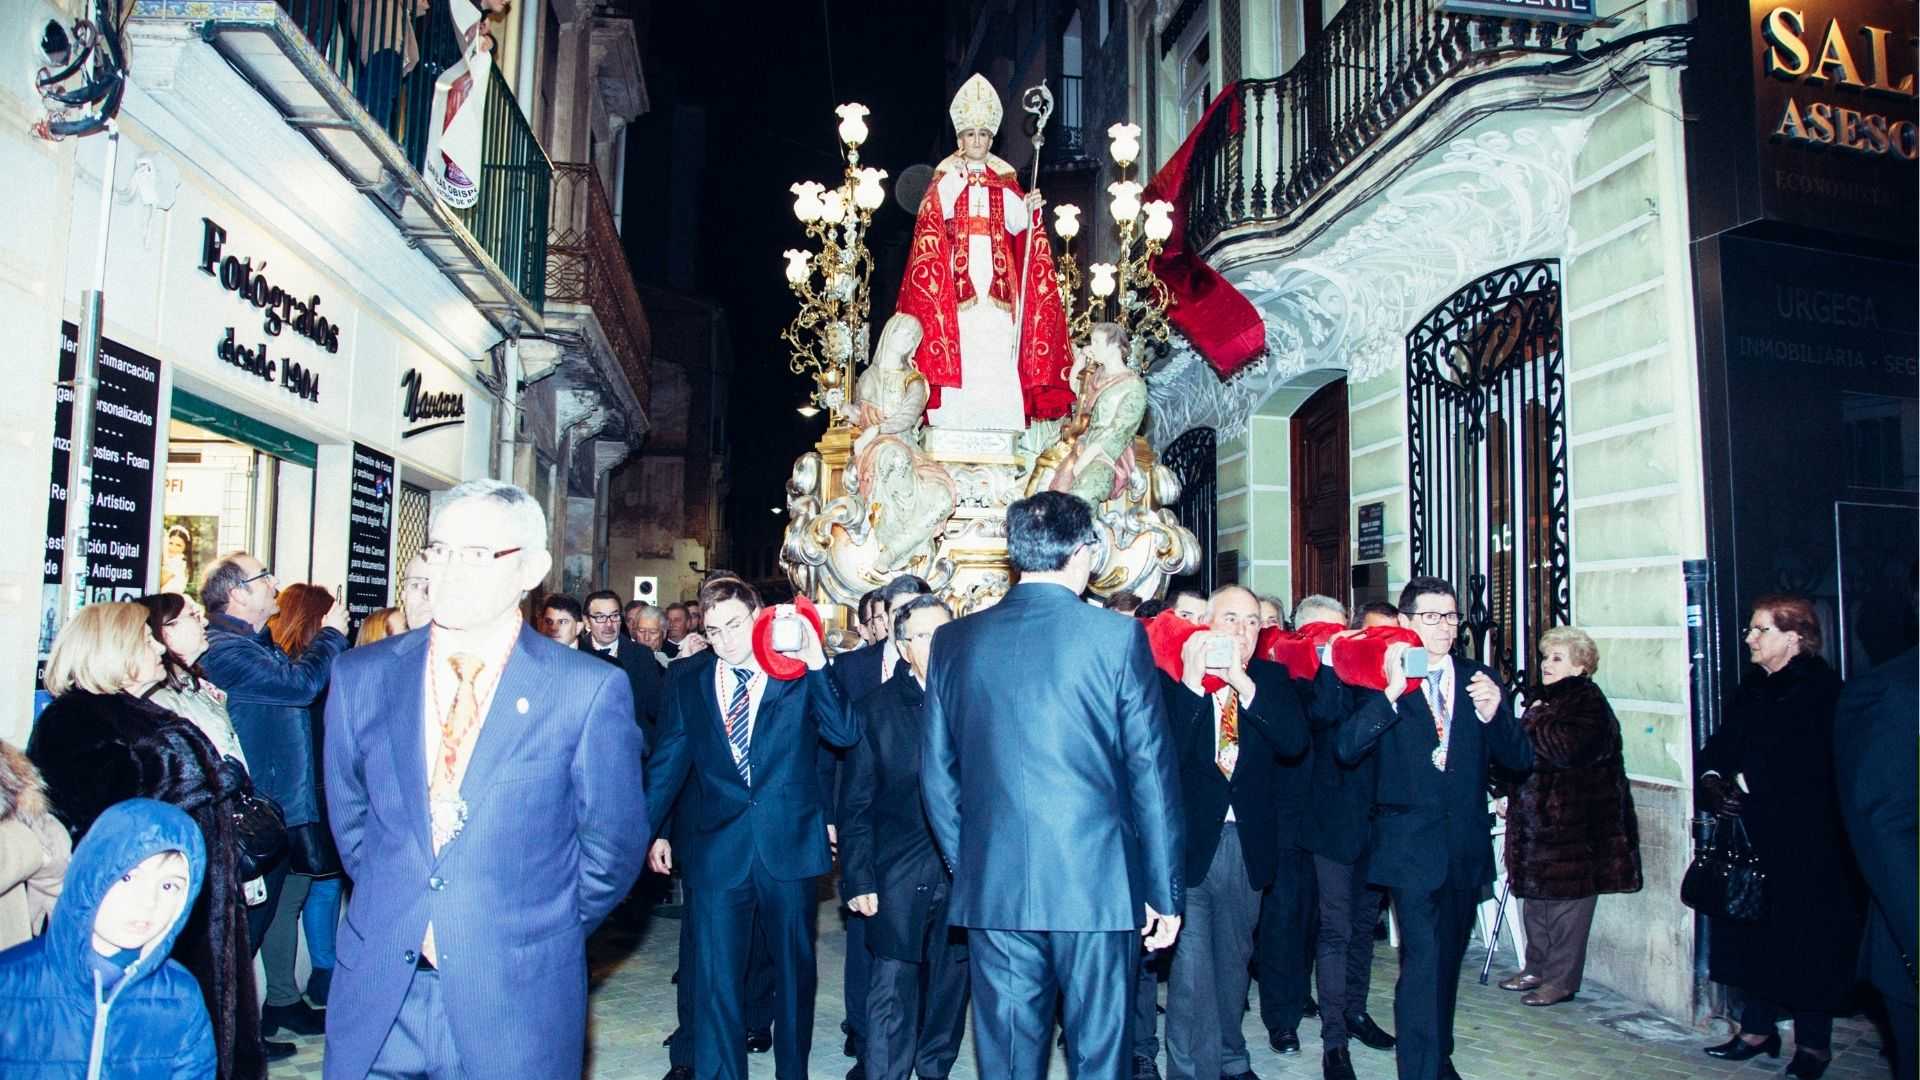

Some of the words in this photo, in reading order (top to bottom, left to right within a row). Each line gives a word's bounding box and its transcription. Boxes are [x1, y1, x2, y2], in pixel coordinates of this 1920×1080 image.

[1775, 98, 1918, 160] ASESO
[198, 217, 340, 354] Fotógrafos
[1776, 285, 1880, 329] URGESA
[99, 349, 155, 382] Enmarcación
[217, 327, 277, 382] desde
[279, 358, 321, 403] 1904
[1739, 335, 1866, 368] INMOBILIARIA
[126, 452, 150, 470] Foam
[96, 492, 136, 512] Artístico
[110, 541, 139, 559] Digital
[45, 560, 58, 575] de
[92, 563, 133, 582] Antiguas
